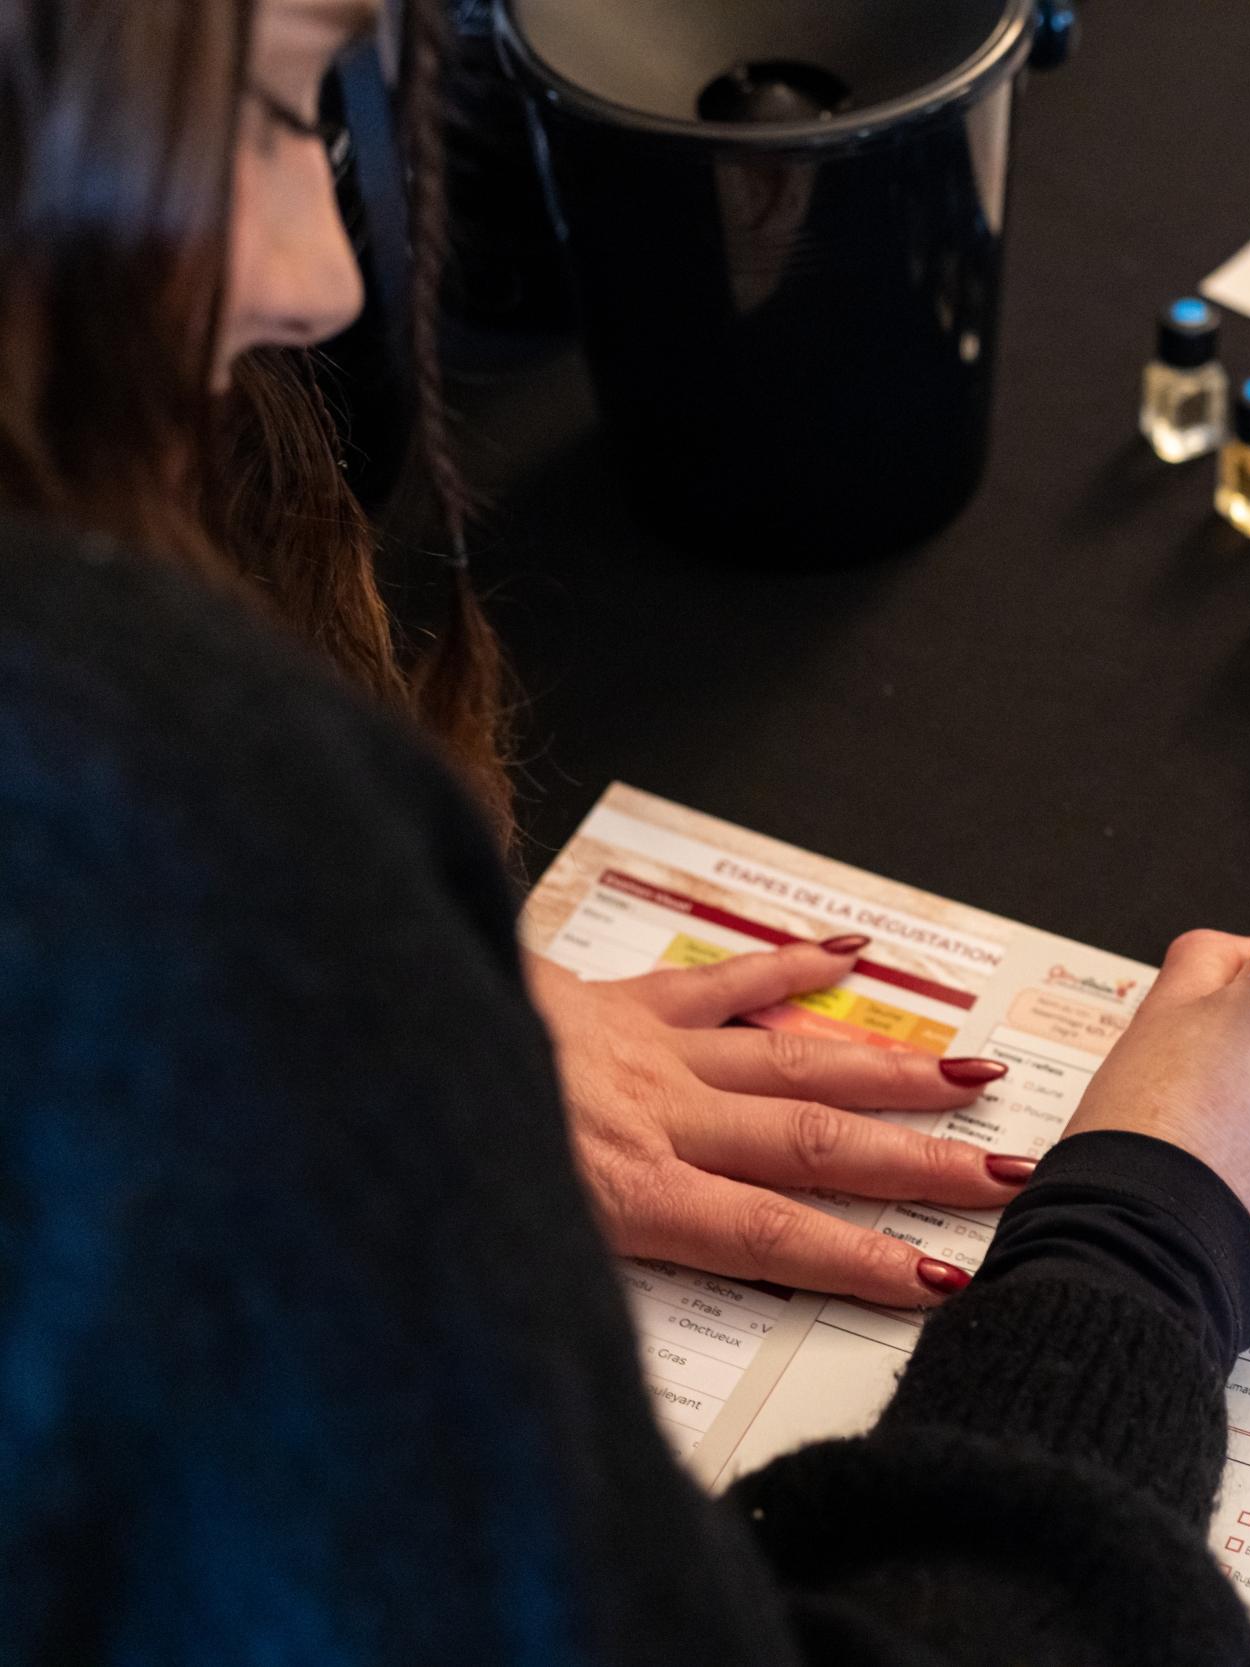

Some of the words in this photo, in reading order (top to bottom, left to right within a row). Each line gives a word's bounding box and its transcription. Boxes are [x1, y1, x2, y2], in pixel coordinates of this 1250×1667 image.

[792, 885, 820, 907] DE
[826, 898, 852, 919] LA
[691, 1299, 722, 1317] Frais
[679, 1318, 742, 1348] Onctueux
[657, 1349, 688, 1366] Gras
